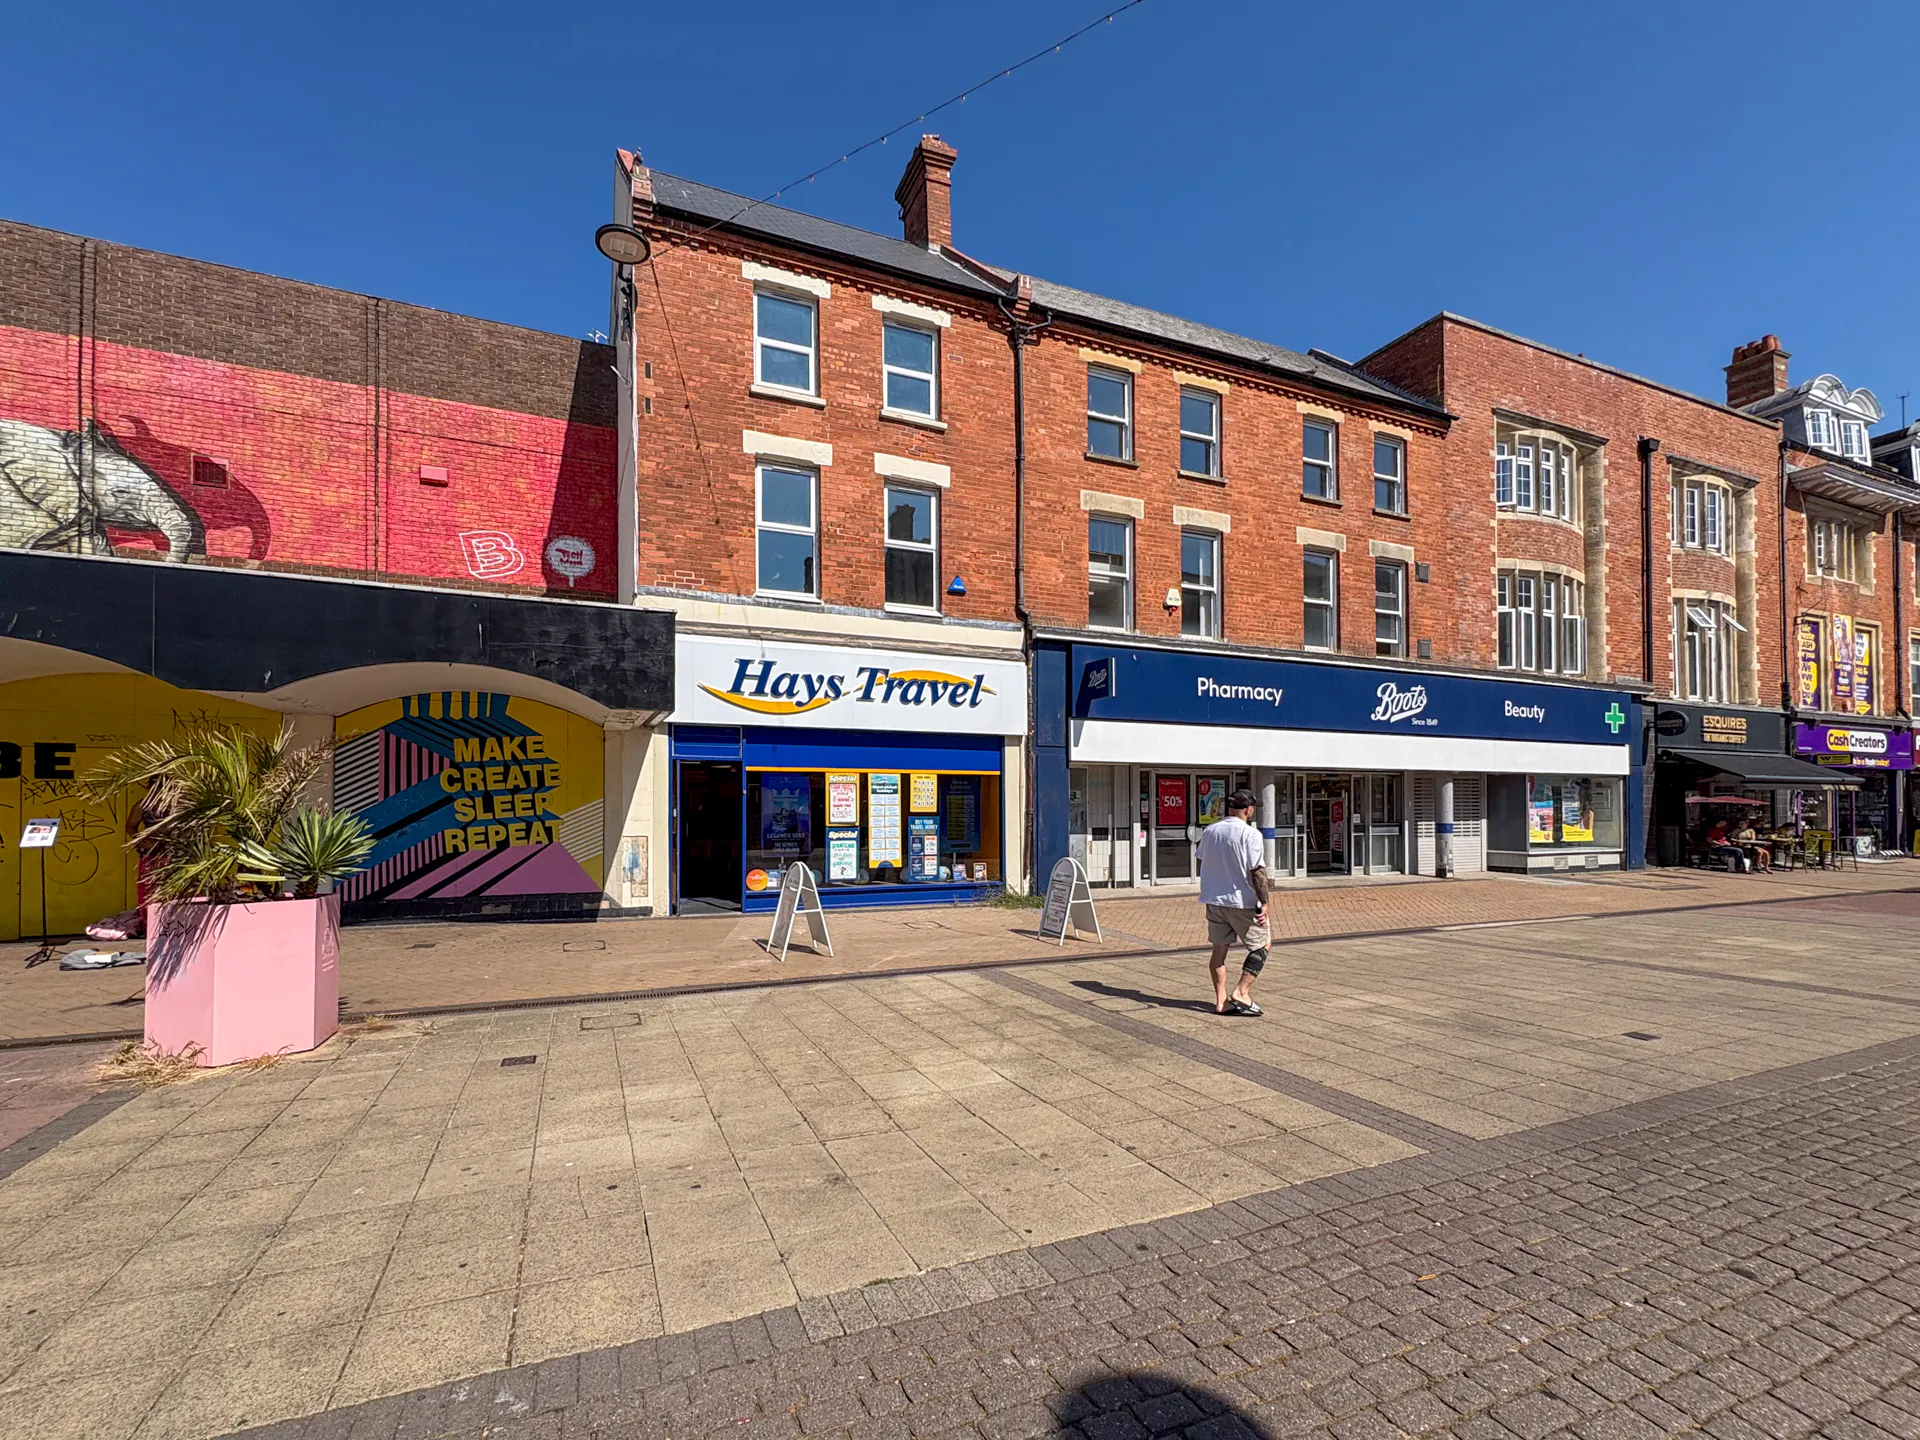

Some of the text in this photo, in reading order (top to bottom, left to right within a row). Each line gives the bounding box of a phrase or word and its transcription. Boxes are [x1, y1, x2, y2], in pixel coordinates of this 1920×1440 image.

[1801, 641, 1813, 650] ASH
[726, 658, 985, 709] Hays Travel
[1197, 677, 1283, 707] Pharmacy
[1371, 682, 1427, 723] Boots
[1504, 700, 1545, 723] Beauty
[1411, 717, 1438, 727] Since 1849
[1703, 715, 1747, 730] ESQUIRES
[453, 735, 546, 763] MAKE
[440, 763, 562, 793] CREATE
[829, 774, 857, 784] Special
[454, 792, 555, 822] SLEEP
[444, 819, 564, 854] REPEAT
[828, 830, 858, 840] Special
